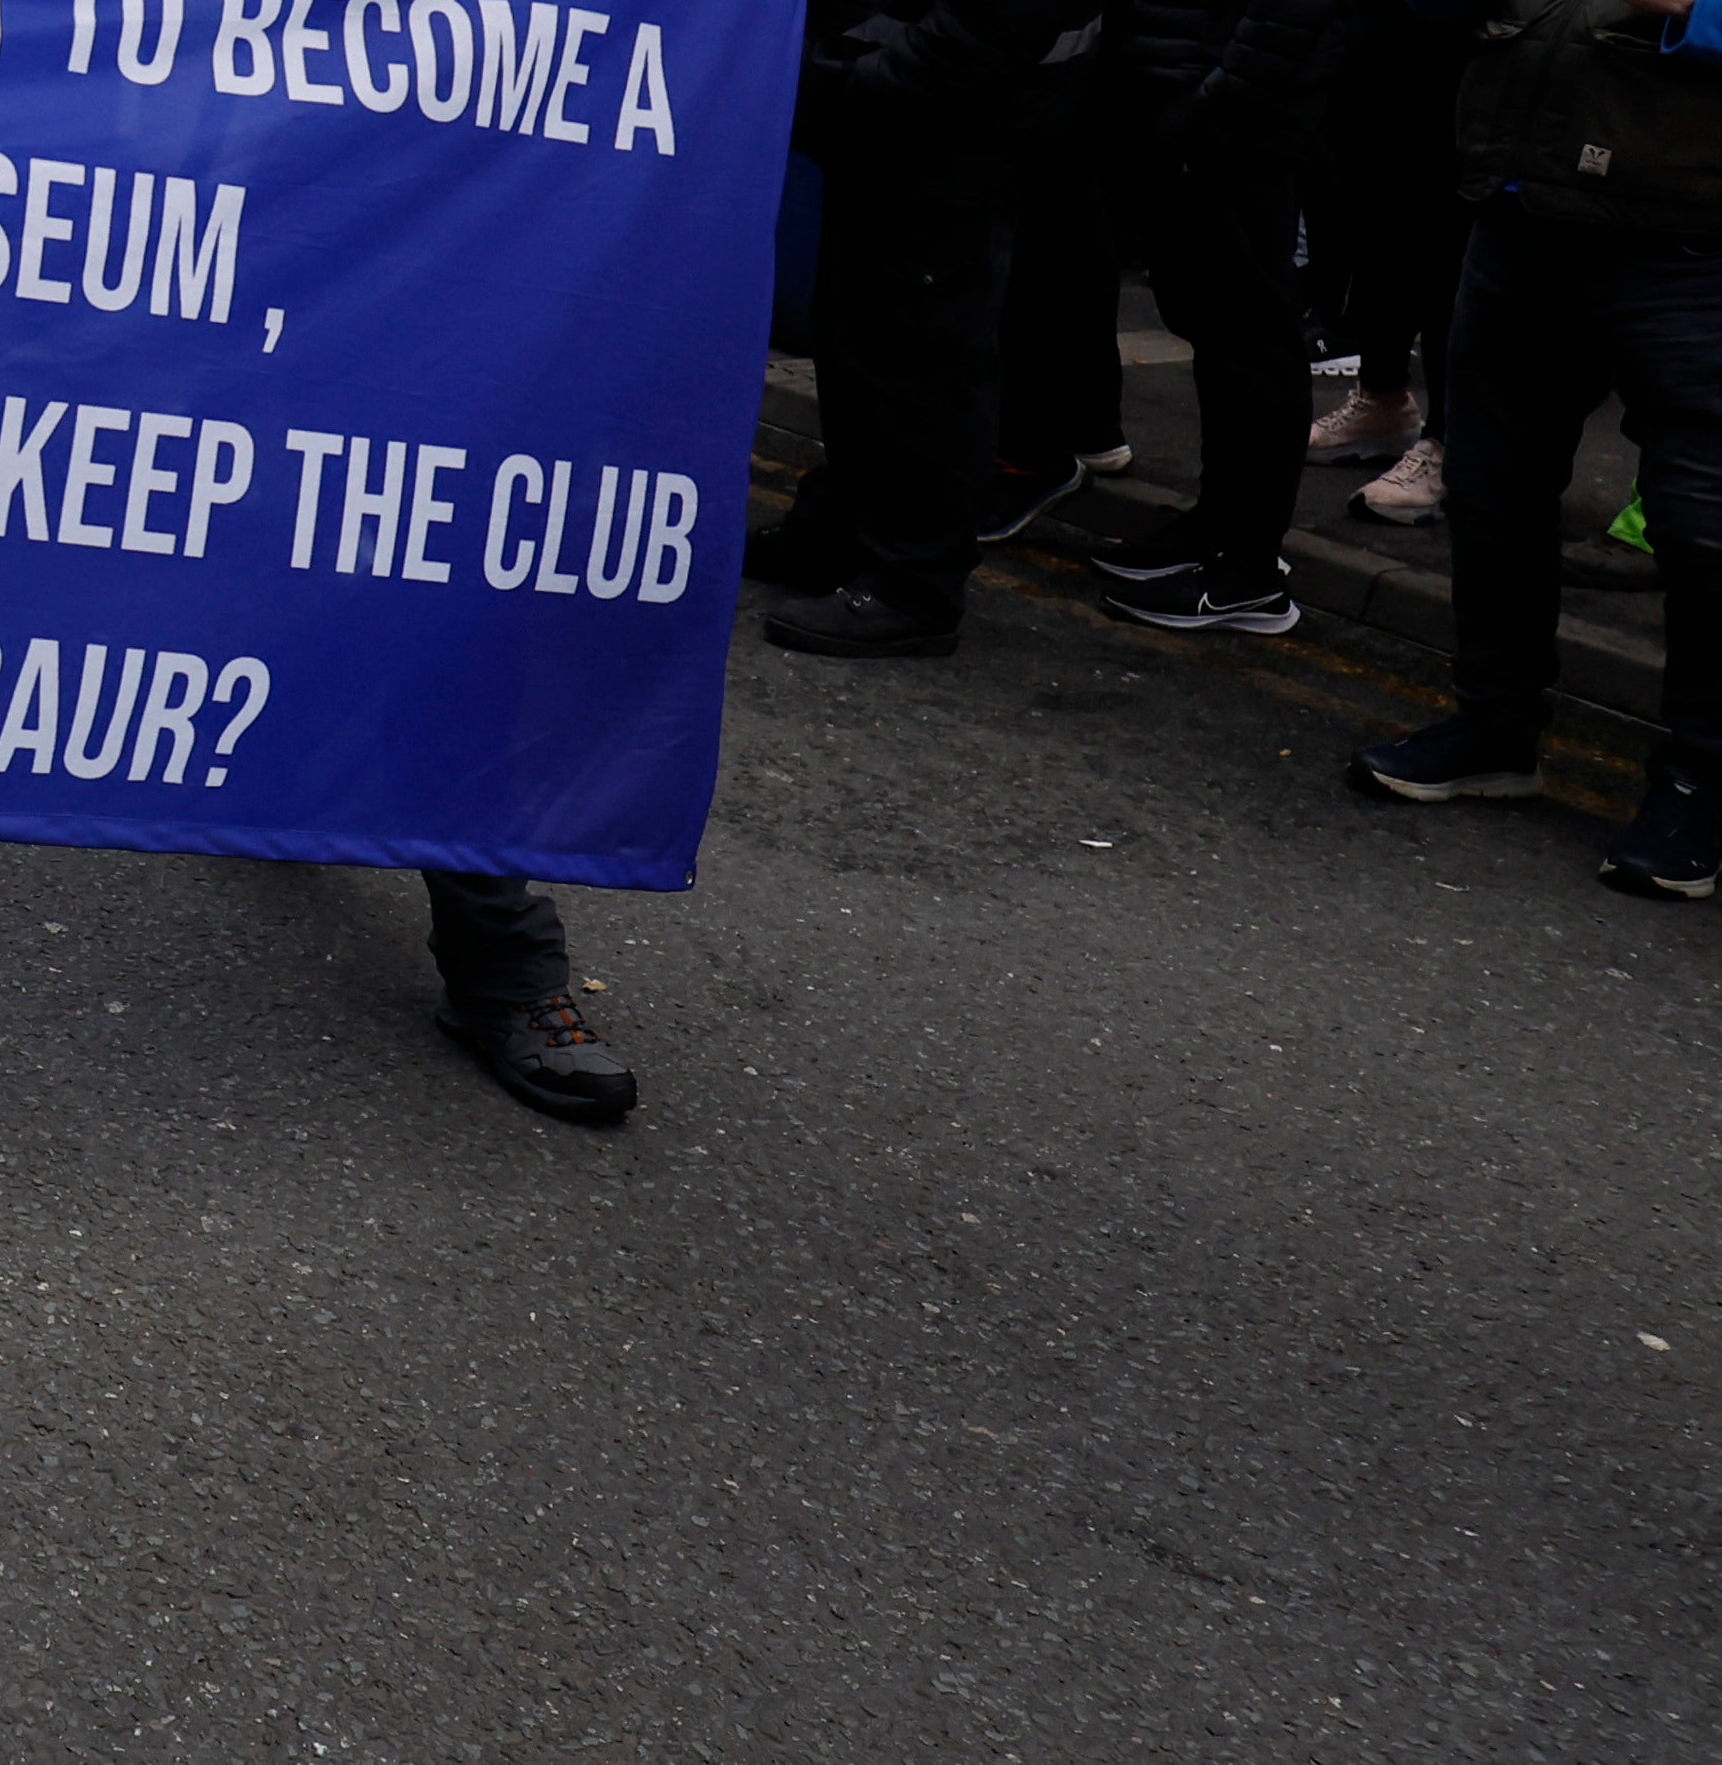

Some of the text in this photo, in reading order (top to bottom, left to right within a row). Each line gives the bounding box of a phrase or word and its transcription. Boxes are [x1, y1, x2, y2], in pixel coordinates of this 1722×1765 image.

[615, 23, 675, 156] A
[286, 429, 467, 583] THE
[484, 454, 698, 603] CLUB
